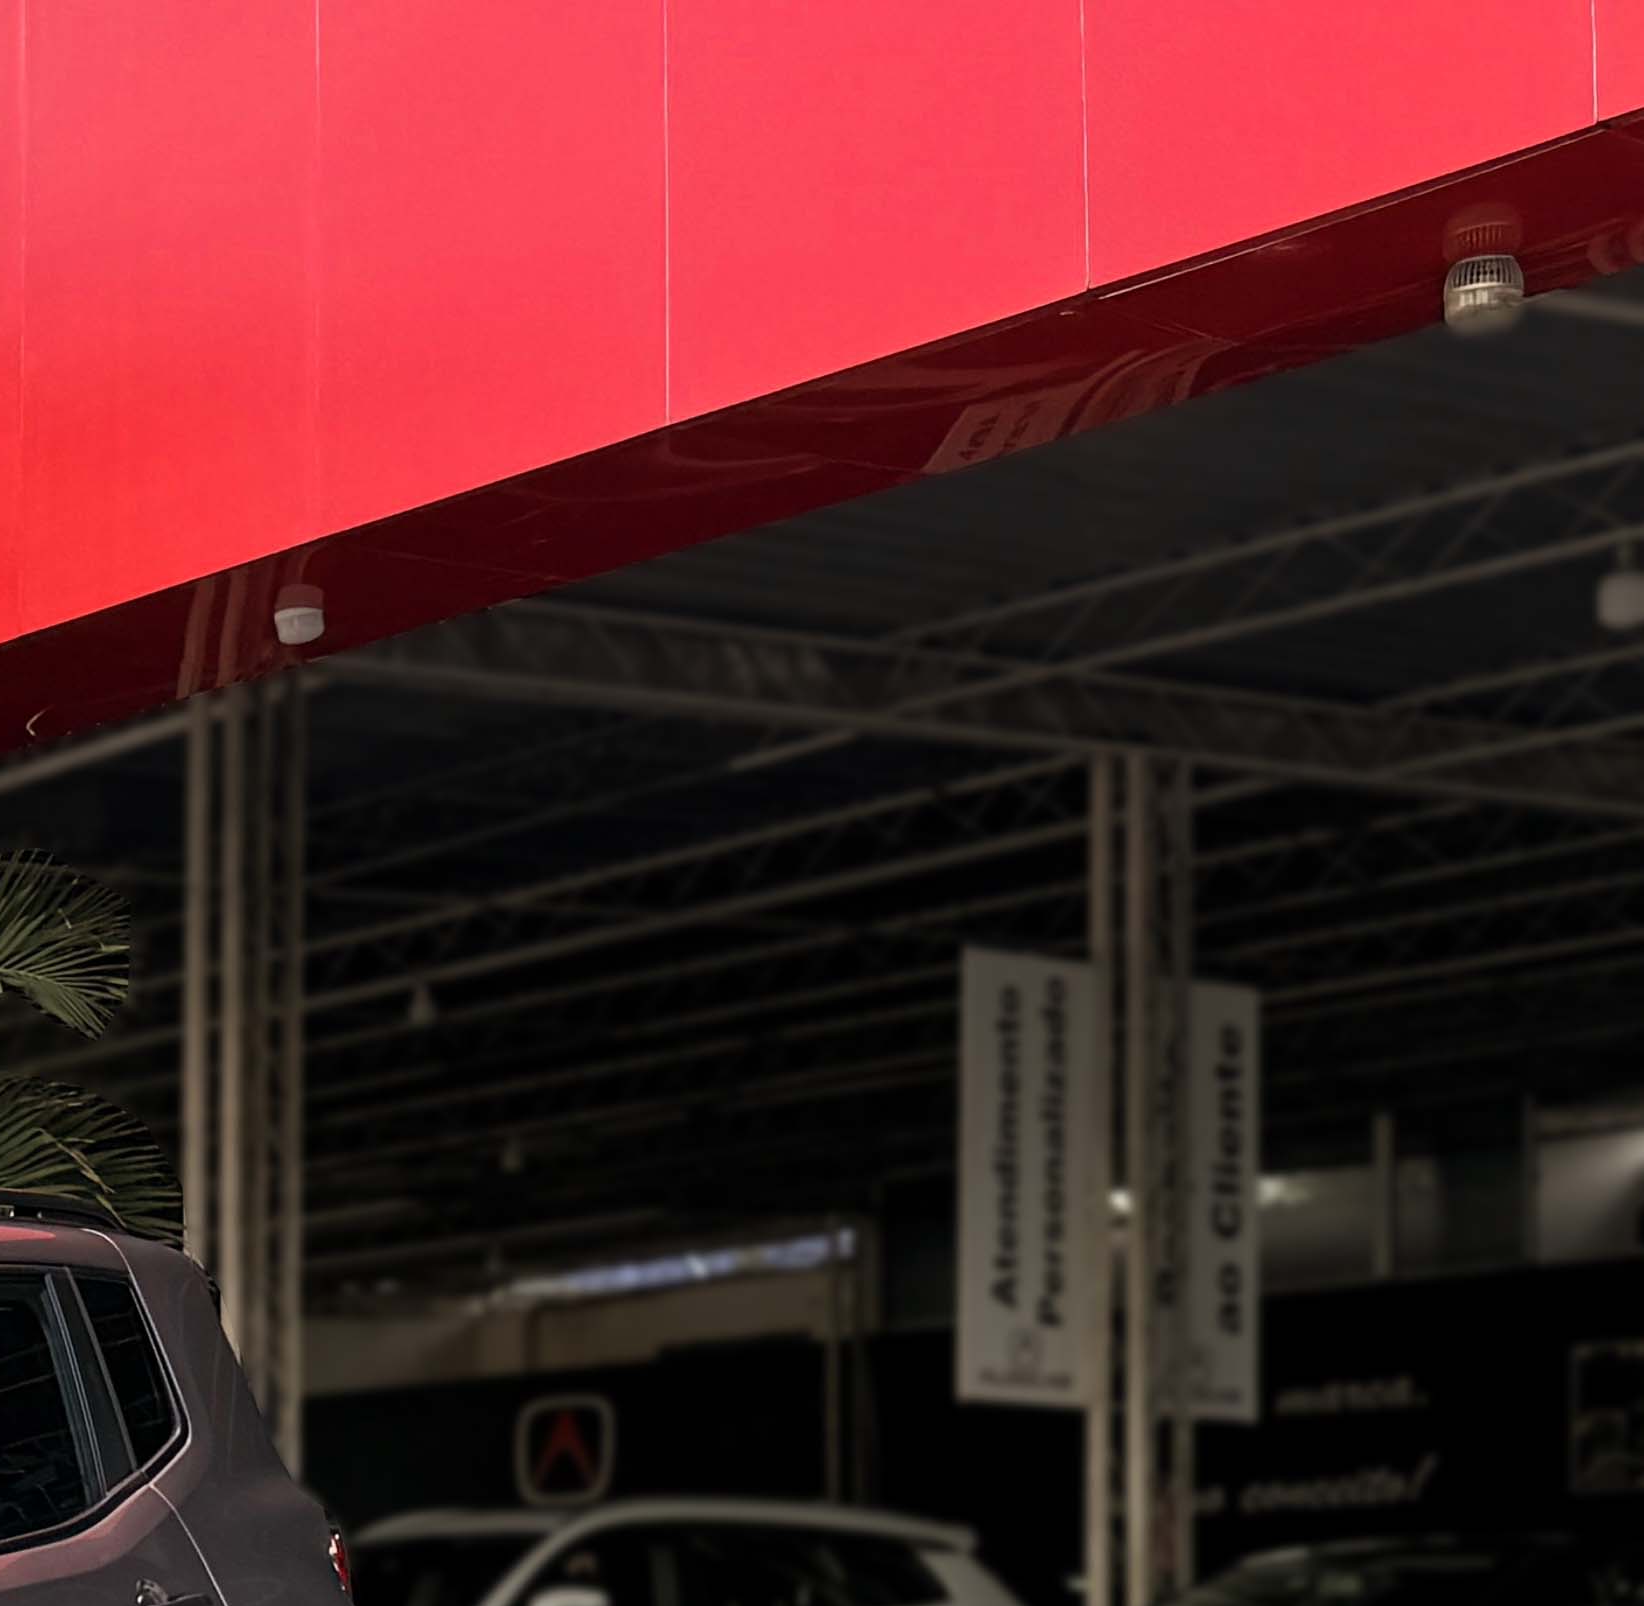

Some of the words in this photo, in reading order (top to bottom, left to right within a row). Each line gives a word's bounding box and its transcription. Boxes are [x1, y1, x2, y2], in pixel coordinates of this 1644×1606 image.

[989, 984, 1023, 1309] Atendimento
[1036, 977, 1068, 1328] Personalizado
[1210, 1024, 1244, 1240] Cliente
